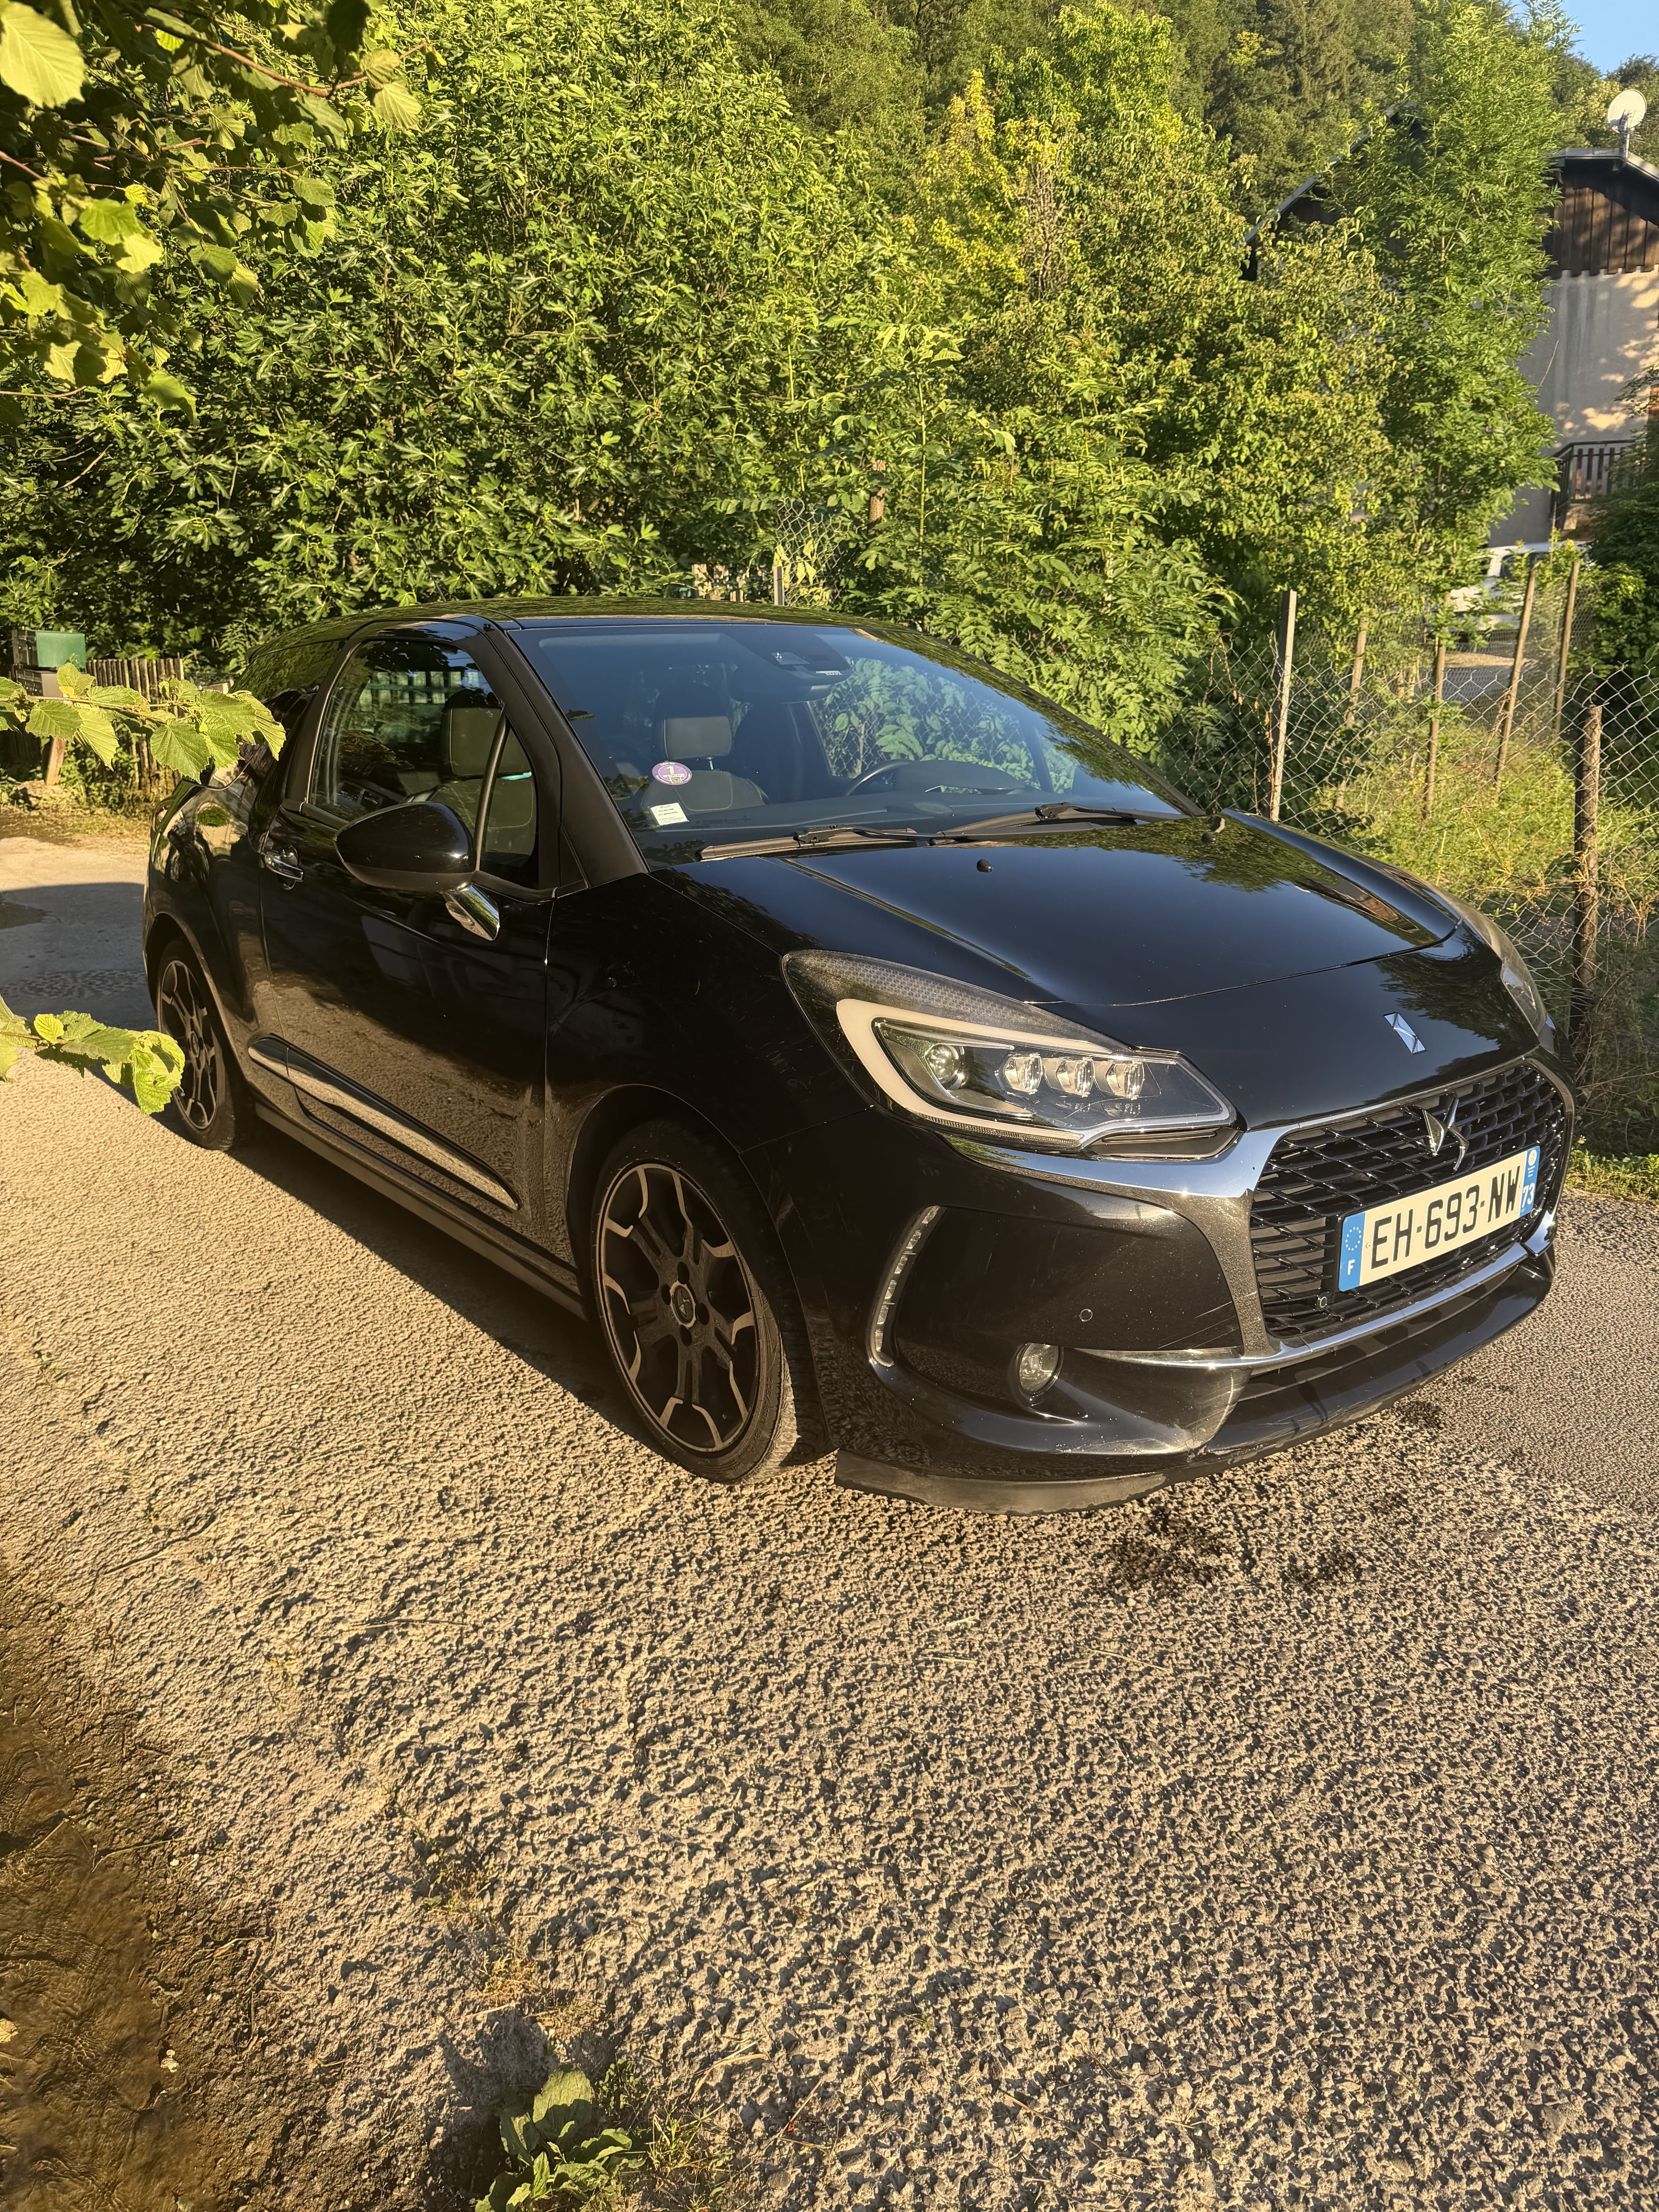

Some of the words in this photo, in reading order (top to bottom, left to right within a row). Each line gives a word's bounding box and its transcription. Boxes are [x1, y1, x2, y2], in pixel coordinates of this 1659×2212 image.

[667, 766, 675, 774] 1
[1522, 1183, 1535, 1208] 73
[1371, 1165, 1520, 1269] EH-693-NW
[1347, 1259, 1355, 1275] F
